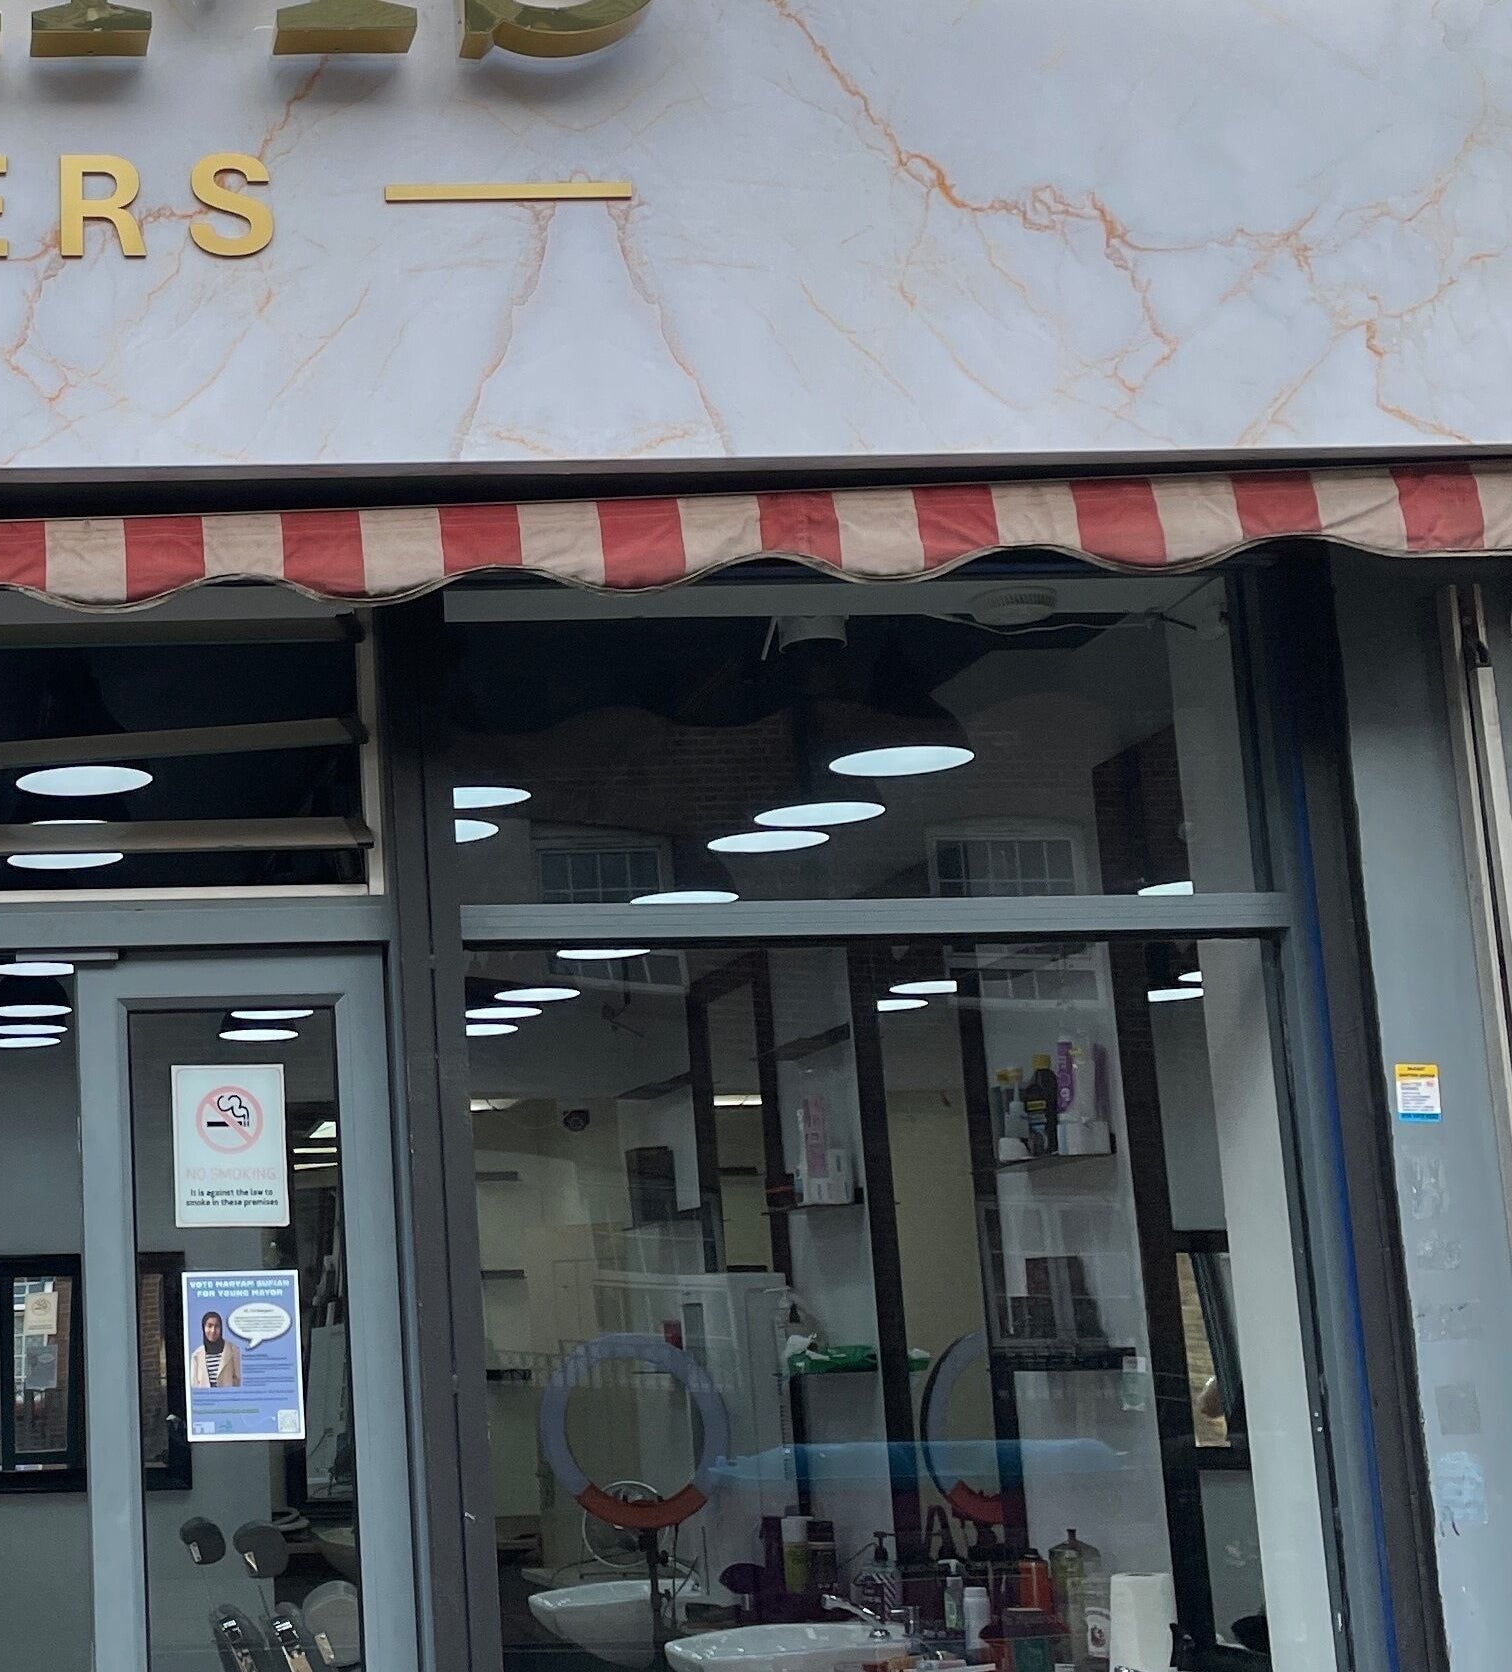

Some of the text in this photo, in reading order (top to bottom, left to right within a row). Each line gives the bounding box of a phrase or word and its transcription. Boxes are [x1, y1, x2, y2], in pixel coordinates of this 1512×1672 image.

[186, 1167, 277, 1181] NO SMOKING
[206, 1189, 234, 1198] against
[235, 1188, 249, 1196] the
[250, 1188, 263, 1196] law
[185, 1198, 211, 1206] smoke
[243, 1198, 279, 1208] premises
[189, 1281, 214, 1289] VOTE
[215, 1280, 255, 1288] MARYAM
[196, 1288, 283, 1298] FOR YOUNG MAYOR
